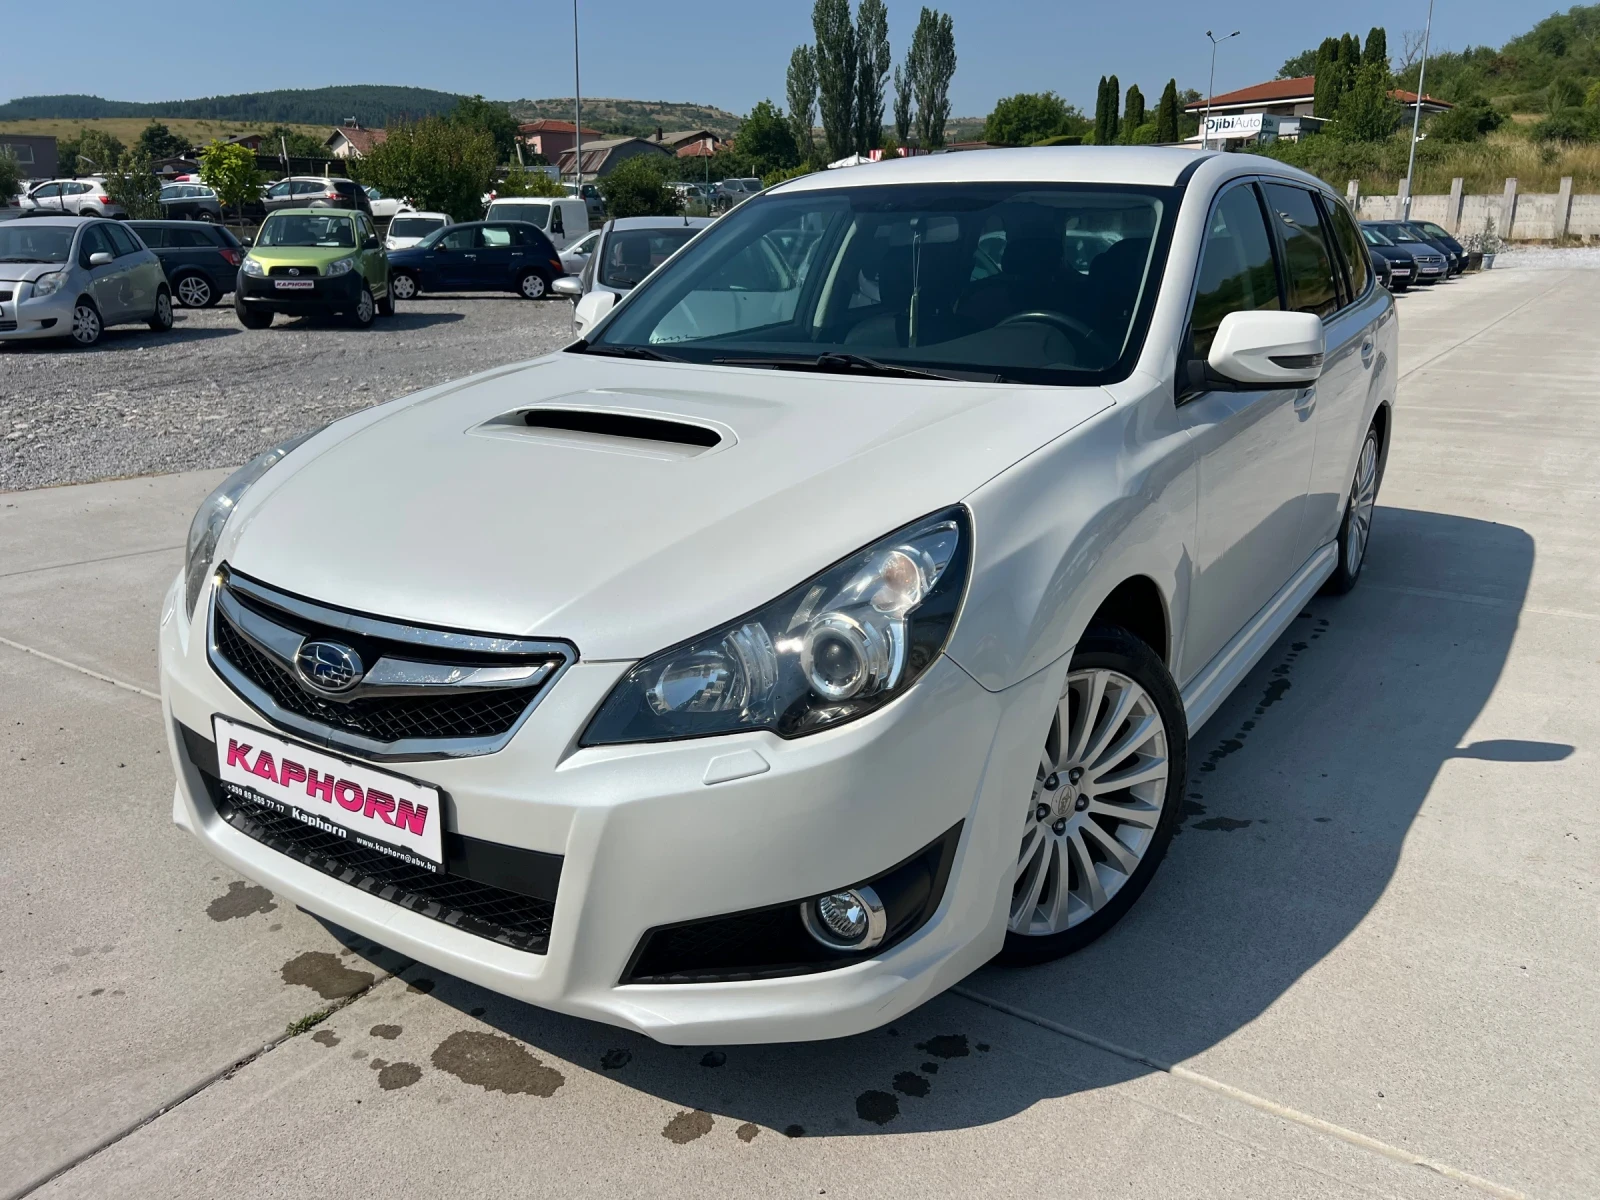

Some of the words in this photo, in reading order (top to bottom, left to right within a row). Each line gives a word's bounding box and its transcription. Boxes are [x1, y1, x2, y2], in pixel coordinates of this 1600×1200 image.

[227, 738, 429, 836] KAPHORN
[266, 799, 275, 809] 77
[276, 804, 285, 813] 17
[291, 807, 347, 839] Kaphorn
[356, 836, 437, 873] www.kaphorn@abv.bg
